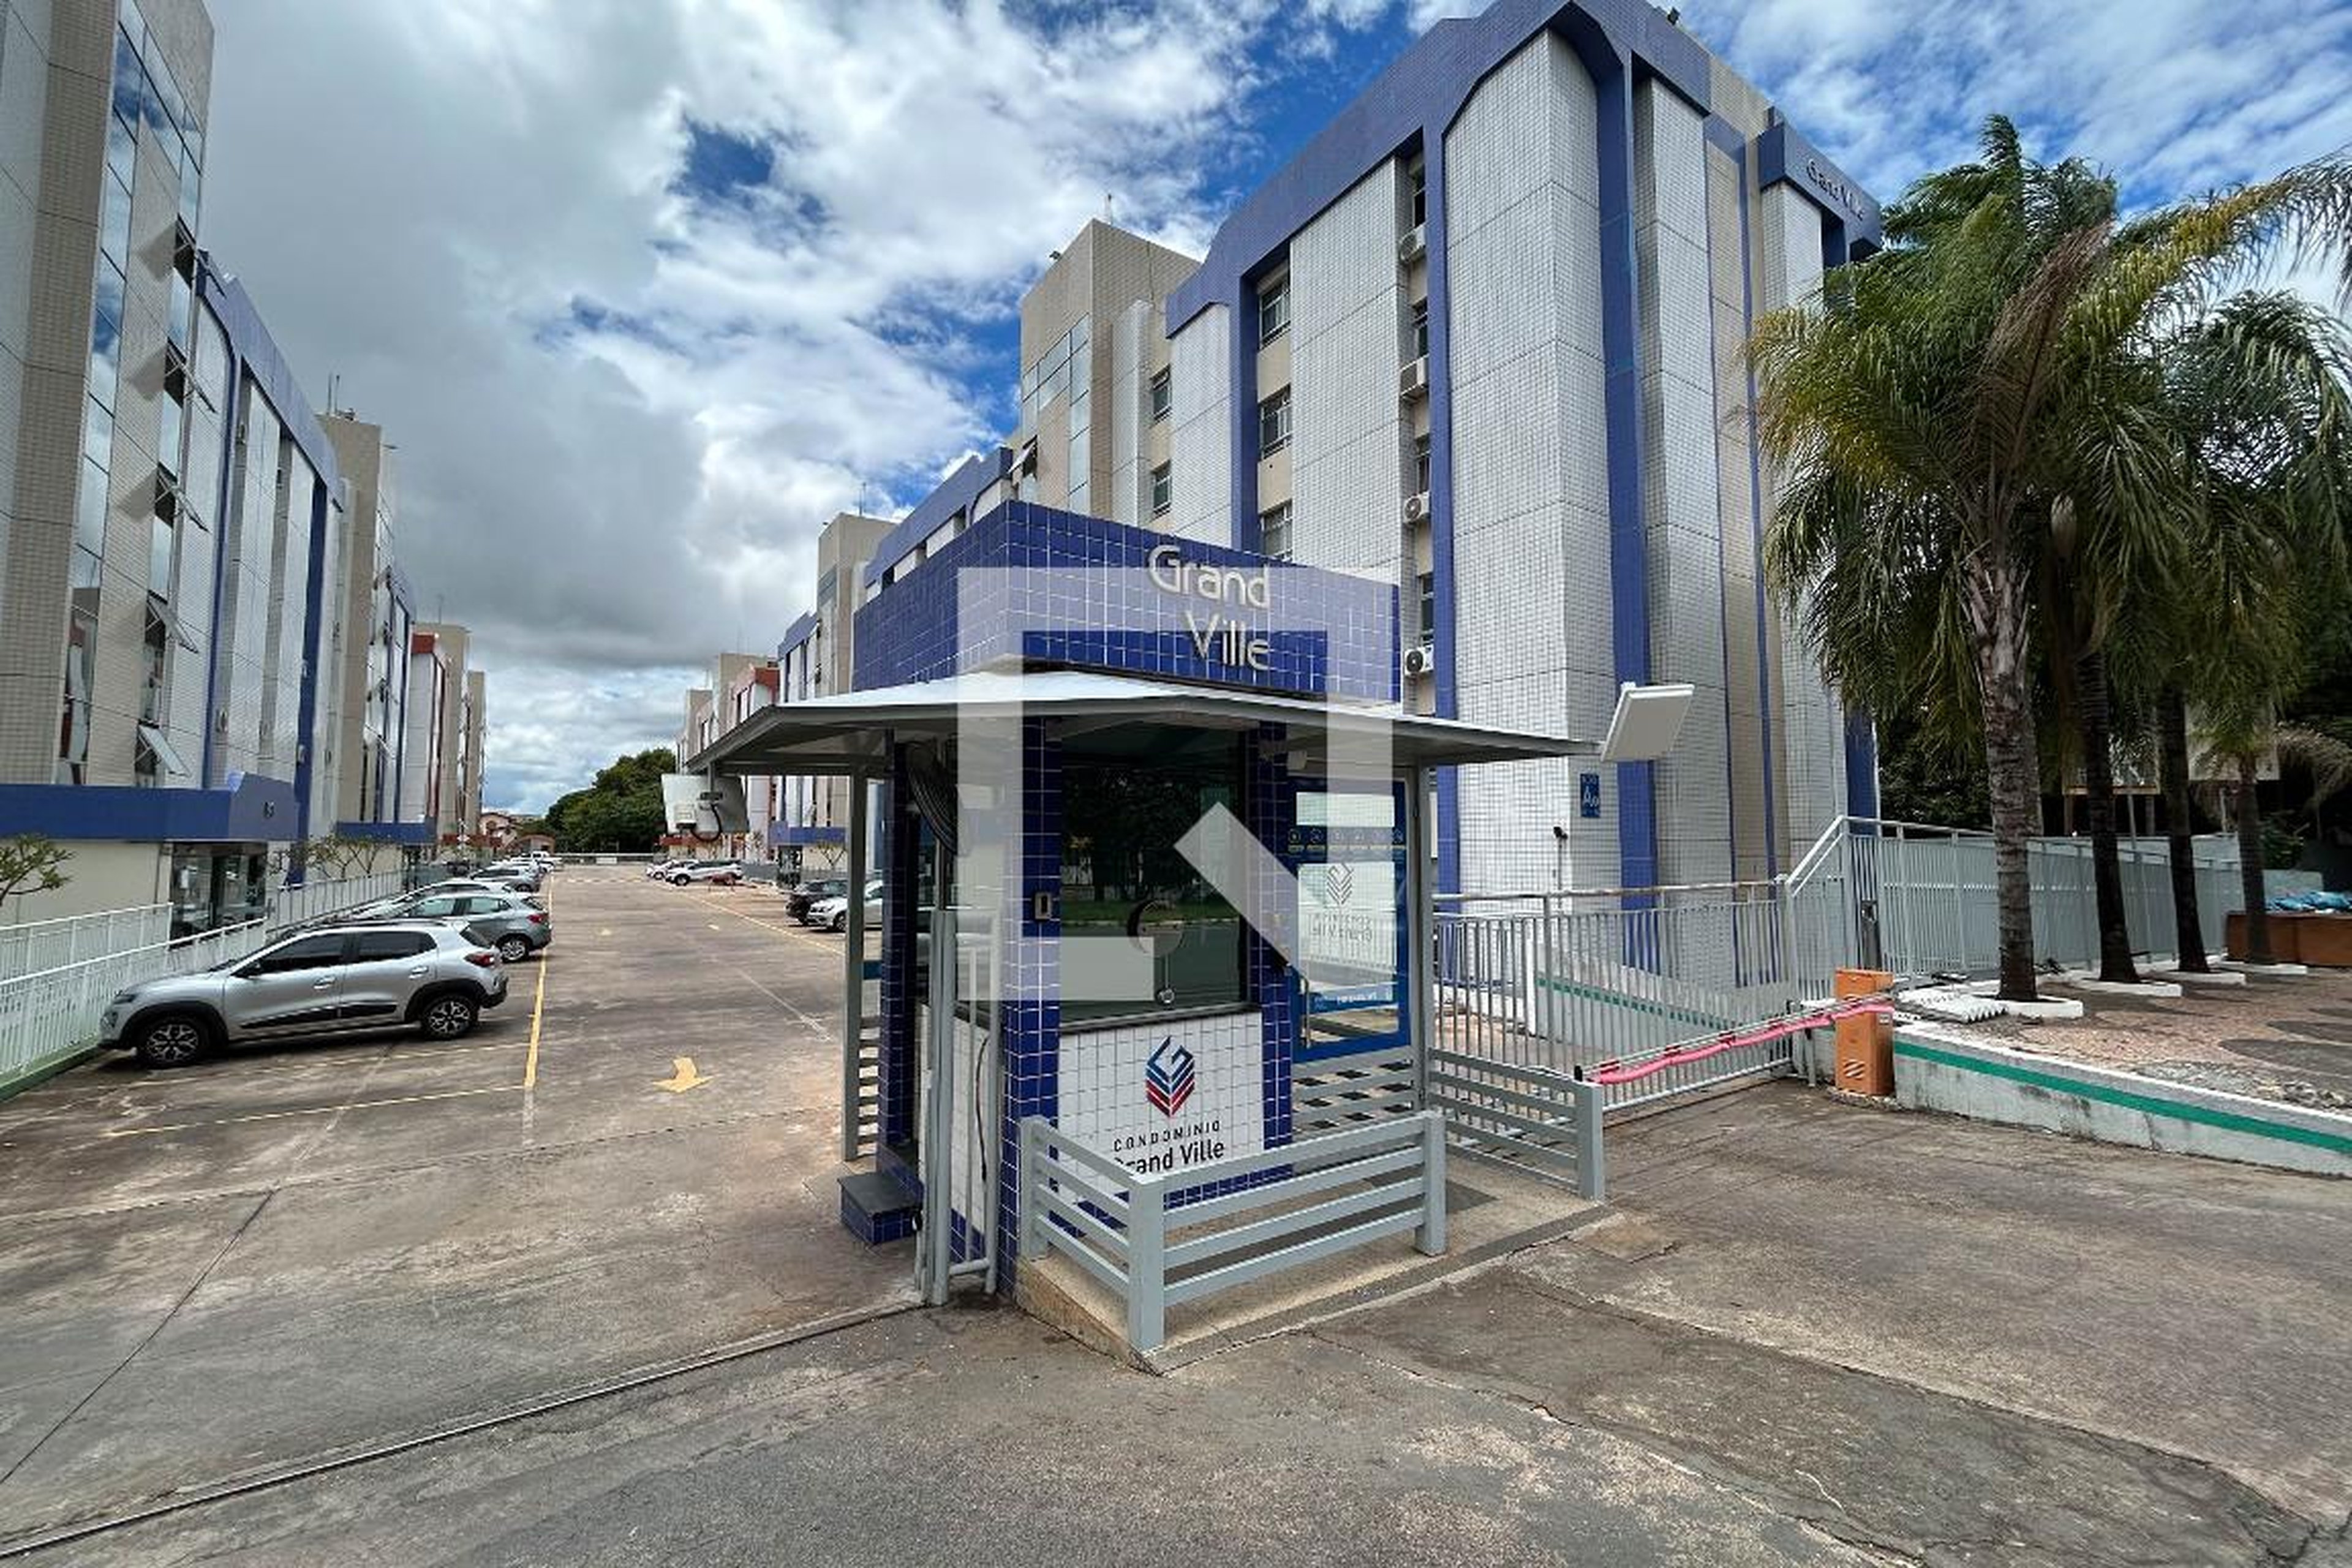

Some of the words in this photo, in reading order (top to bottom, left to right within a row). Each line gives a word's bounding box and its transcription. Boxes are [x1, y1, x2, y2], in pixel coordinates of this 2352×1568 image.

[1148, 545, 1270, 608] Grand
[1185, 611, 1270, 671] Ville
[1115, 1147, 1173, 1174] and
[1180, 1139, 1225, 1164] Ville
